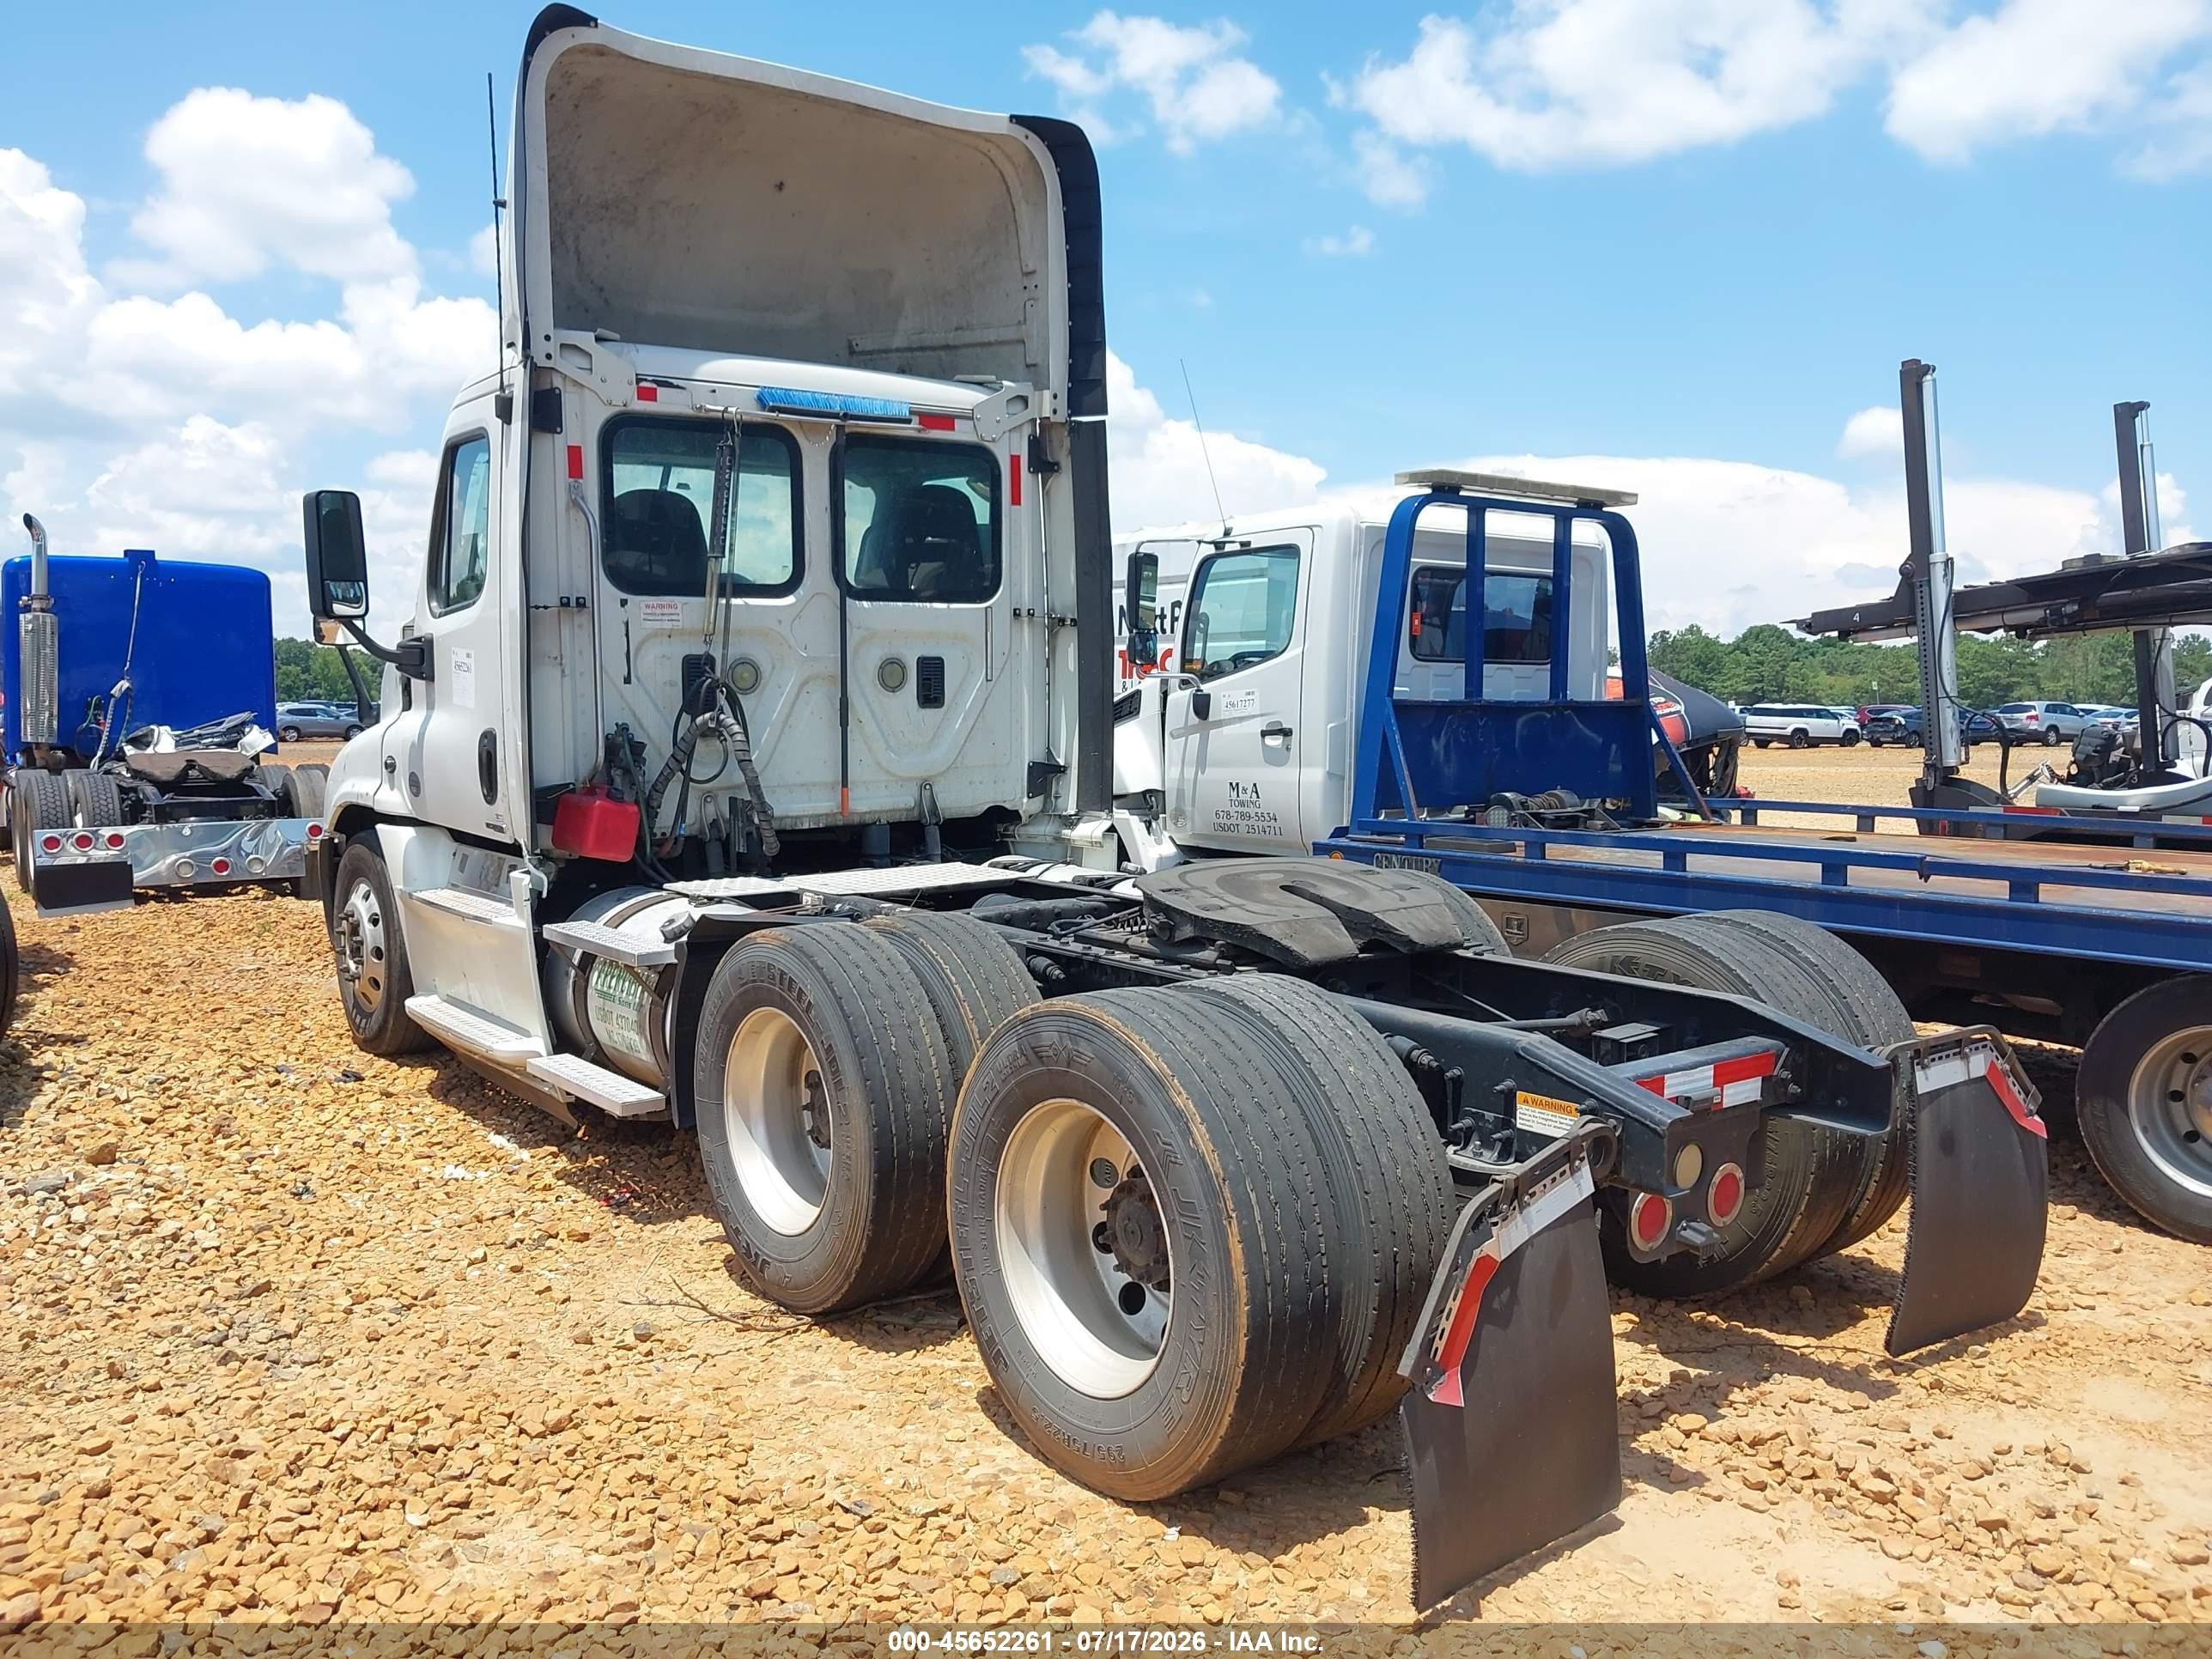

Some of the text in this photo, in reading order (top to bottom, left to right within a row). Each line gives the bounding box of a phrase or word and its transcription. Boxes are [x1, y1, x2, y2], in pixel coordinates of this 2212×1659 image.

[1852, 612, 1860, 623] 4
[1229, 799, 1261, 809] TOWING
[1215, 810, 1278, 823] 678-789-5534
[1212, 823, 1284, 836] USDOT 2514711
[1530, 1097, 1573, 1115] WARNING
[1030, 1404, 1126, 1463] 295/75R22.5
